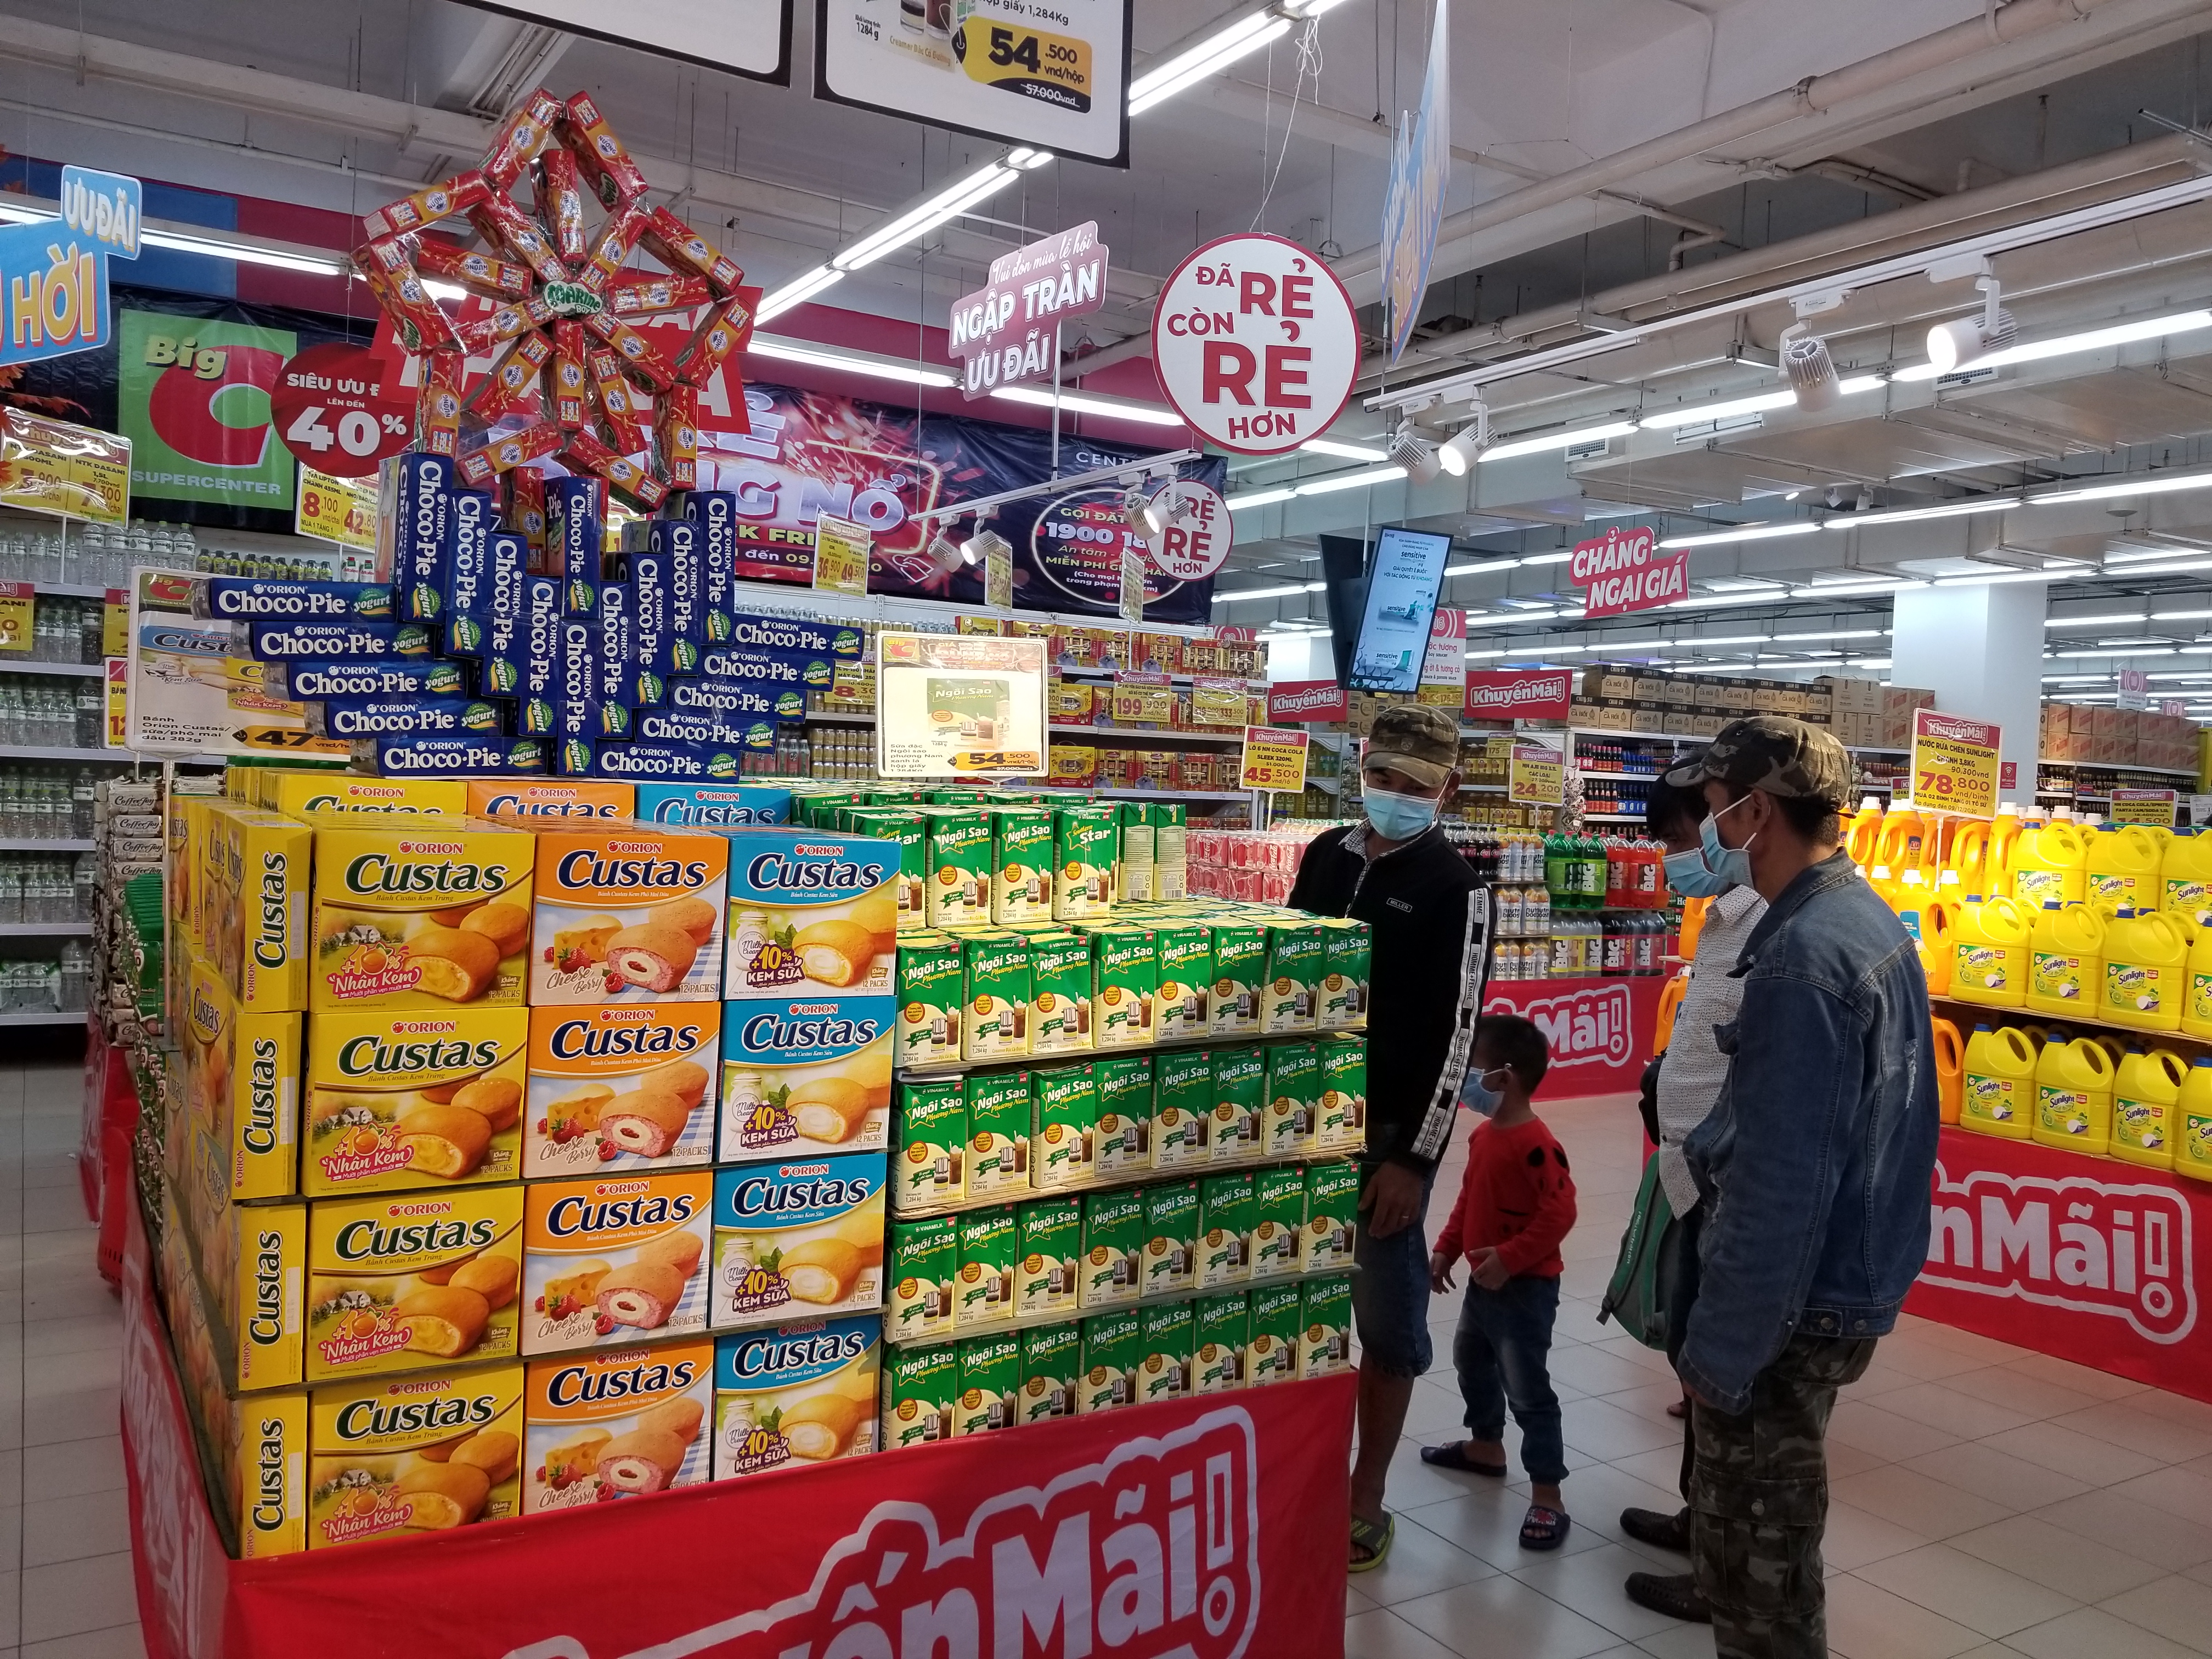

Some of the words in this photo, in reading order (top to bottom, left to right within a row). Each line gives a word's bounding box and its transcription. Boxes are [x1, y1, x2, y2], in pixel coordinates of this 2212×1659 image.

[1028, 4, 1069, 26] 1,284Kg
[988, 26, 1041, 74] 54
[1044, 65, 1085, 84] vnd/hộp
[12, 241, 98, 348] HỜI
[1195, 263, 1235, 287] ĐÃ
[1240, 258, 1314, 320] RẺ
[952, 289, 1016, 349] NGẬP
[1022, 261, 1099, 323] TRÀN
[1167, 307, 1234, 336] CÒN
[146, 335, 228, 380] Big
[967, 348, 1000, 394] ƯU
[1002, 328, 1051, 383] ĐÃI
[1203, 320, 1312, 409] RẺ
[287, 373, 331, 391] SIÊU
[337, 378, 365, 394] ƯU
[327, 397, 344, 407] LÊN
[346, 399, 365, 409] ĐẾN
[287, 406, 407, 456] 40%
[1228, 410, 1296, 439] HƠN
[94, 464, 125, 476] DASANI
[131, 470, 281, 495] SUPERCENTER
[303, 492, 320, 517] 8
[797, 473, 909, 533] NỔ
[344, 509, 363, 535] 42
[437, 503, 445, 541] ORION
[1060, 507, 1090, 521] GỌI
[1046, 522, 1114, 544] 1900
[1161, 521, 1213, 562] RẺ
[745, 549, 778, 562] đến
[1058, 544, 1077, 553] An
[1080, 546, 1107, 557] tâm
[1401, 550, 1426, 560] sensitive
[1573, 530, 1649, 578] CHẲNG
[817, 557, 829, 579] 36
[842, 562, 853, 581] 49
[1046, 555, 1080, 567] MIỄN
[1084, 560, 1107, 569] PHÍ
[1173, 561, 1202, 574] HƠN
[1066, 577, 1092, 586] trong
[1094, 580, 1120, 589] phạm
[1074, 570, 1101, 579] (Cho
[1589, 573, 1644, 612] NGẠI
[1645, 555, 1684, 599] GIÁ
[267, 585, 306, 594] ORION
[353, 595, 390, 613] yogurt
[770, 621, 799, 631] ORION
[832, 636, 860, 651] yogurt
[834, 686, 856, 697] 8
[935, 688, 965, 698] Ngôi
[1115, 698, 1142, 715] 199
[254, 730, 315, 746] 47
[968, 753, 1006, 764] 54
[1917, 739, 1935, 747] NƯỚC
[1936, 741, 1948, 751] RỬA
[1950, 744, 1965, 754] CHÉN
[1966, 748, 1995, 759] SUNLIGHT
[1244, 767, 1272, 782] 45
[1920, 770, 1953, 794] 78
[1514, 782, 1537, 797] 24
[941, 828, 966, 846] Ngôi
[968, 827, 989, 838] Sao
[416, 843, 464, 855] ORION
[621, 842, 663, 854] ORION
[807, 844, 844, 857] ORION
[345, 854, 510, 895] Custas
[556, 850, 709, 889] Custas
[746, 852, 884, 890] Custas
[1583, 863, 1595, 891] BIG
[2026, 870, 2050, 889] Sunlight
[253, 850, 288, 969] Custas
[1390, 899, 1409, 910] MILLER
[1607, 939, 1620, 967] BIG
[1968, 950, 1994, 965] Sunlight
[747, 969, 773, 983] KEM
[774, 965, 804, 981] SỮA
[908, 961, 937, 981] Ngôi
[939, 958, 960, 969] Sao
[335, 976, 379, 994] Nhân
[381, 969, 415, 986] Kem
[546, 967, 592, 990] Cheese
[573, 977, 603, 995] Berry
[498, 990, 521, 999] PACKS
[1324, 1053, 1344, 1071] Ngôi
[1345, 1052, 1363, 1062] Sao
[2125, 1107, 2151, 1120] Sunlight
